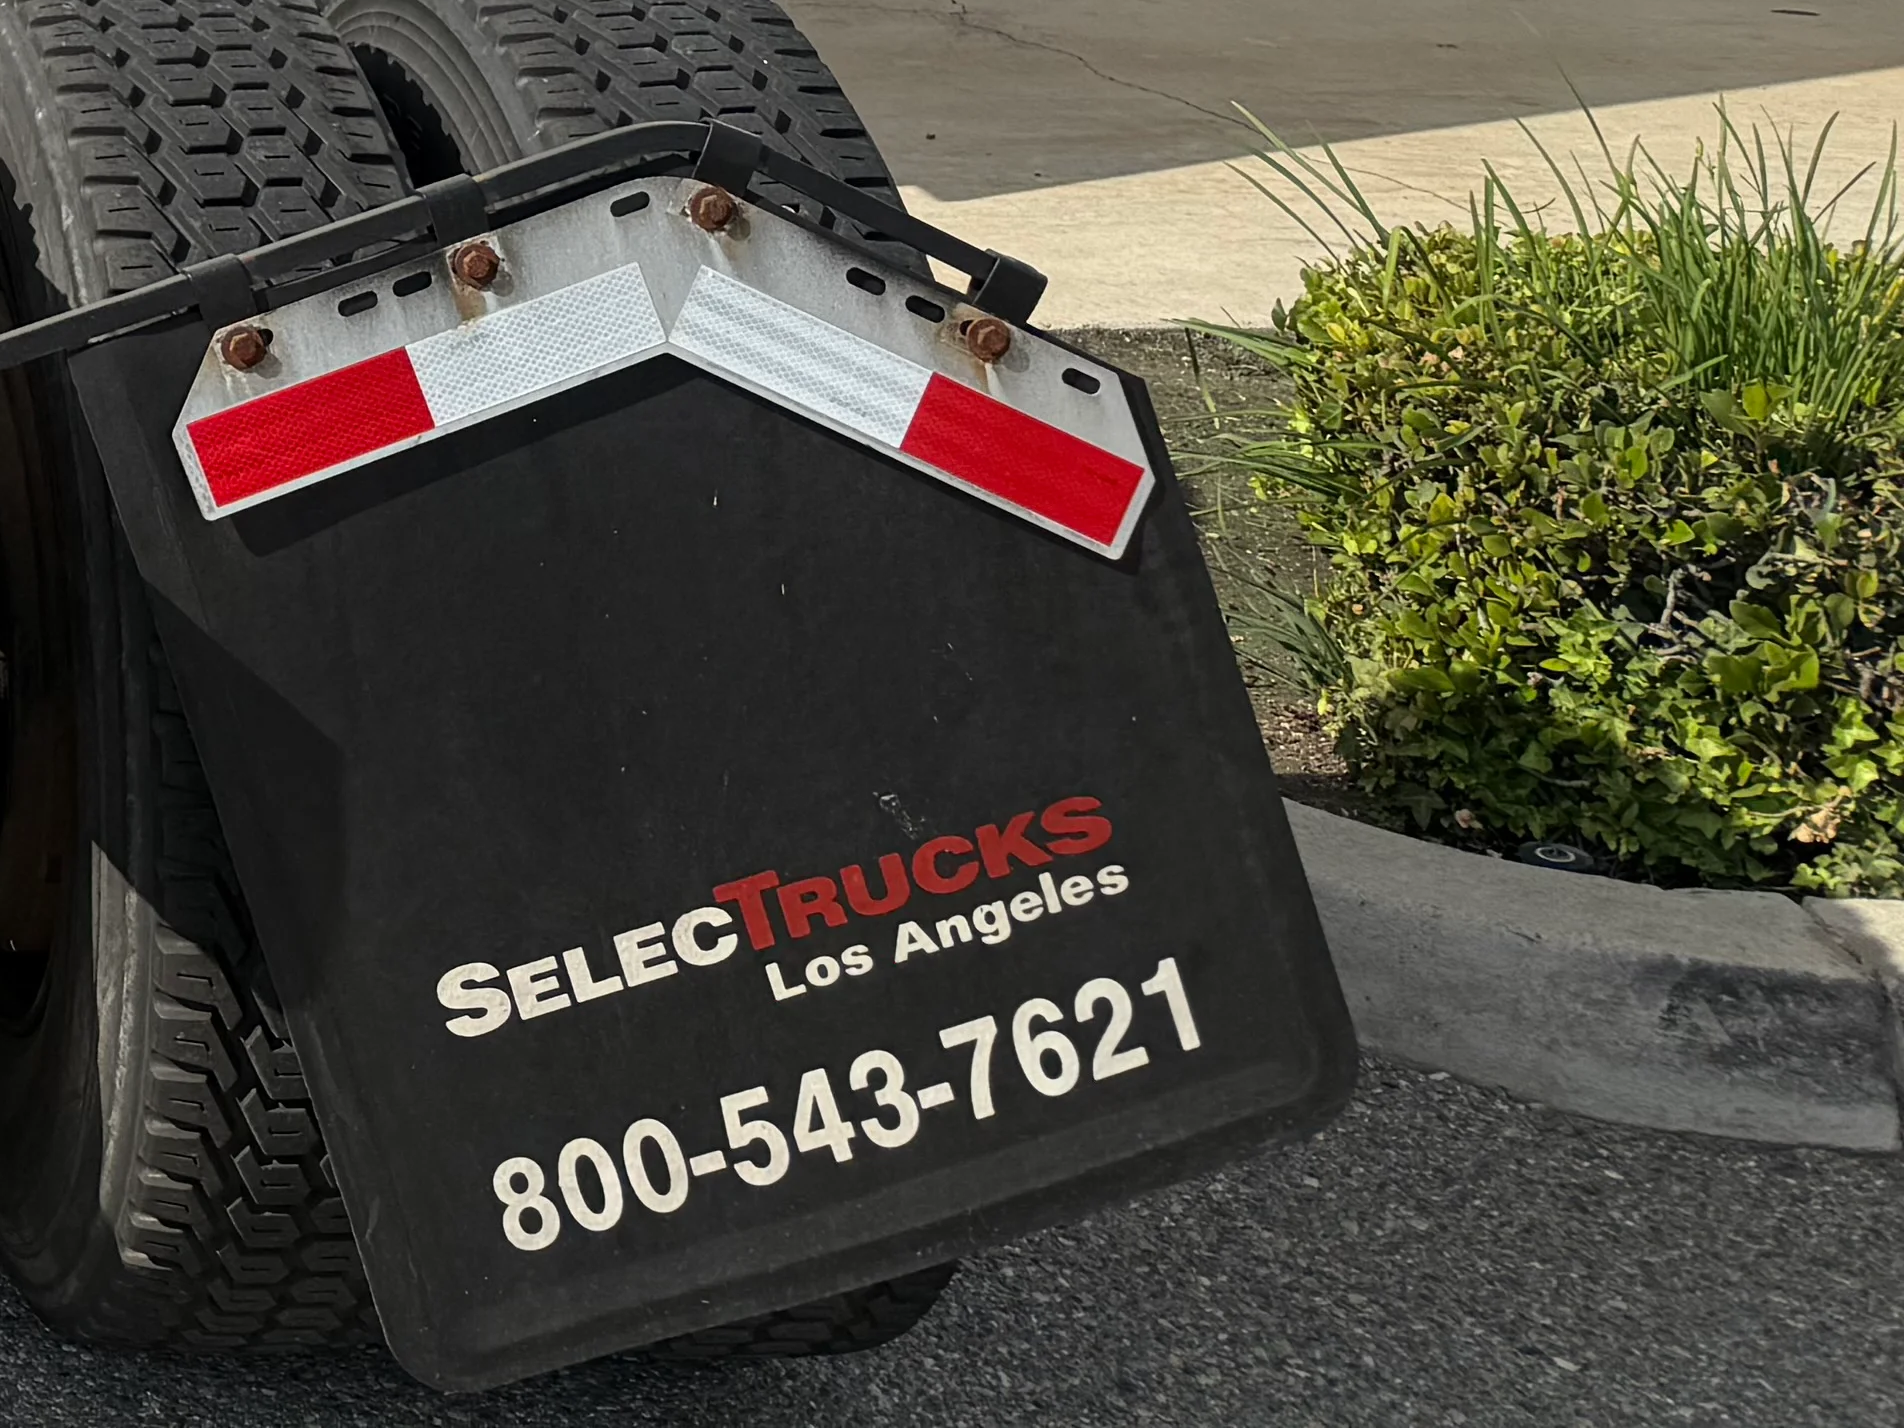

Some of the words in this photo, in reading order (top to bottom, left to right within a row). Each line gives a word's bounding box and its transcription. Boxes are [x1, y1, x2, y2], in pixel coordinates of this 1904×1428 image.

[764, 938, 875, 1001] Los
[893, 864, 1130, 963] Angeles
[492, 957, 1202, 1252] 800-543-7621
